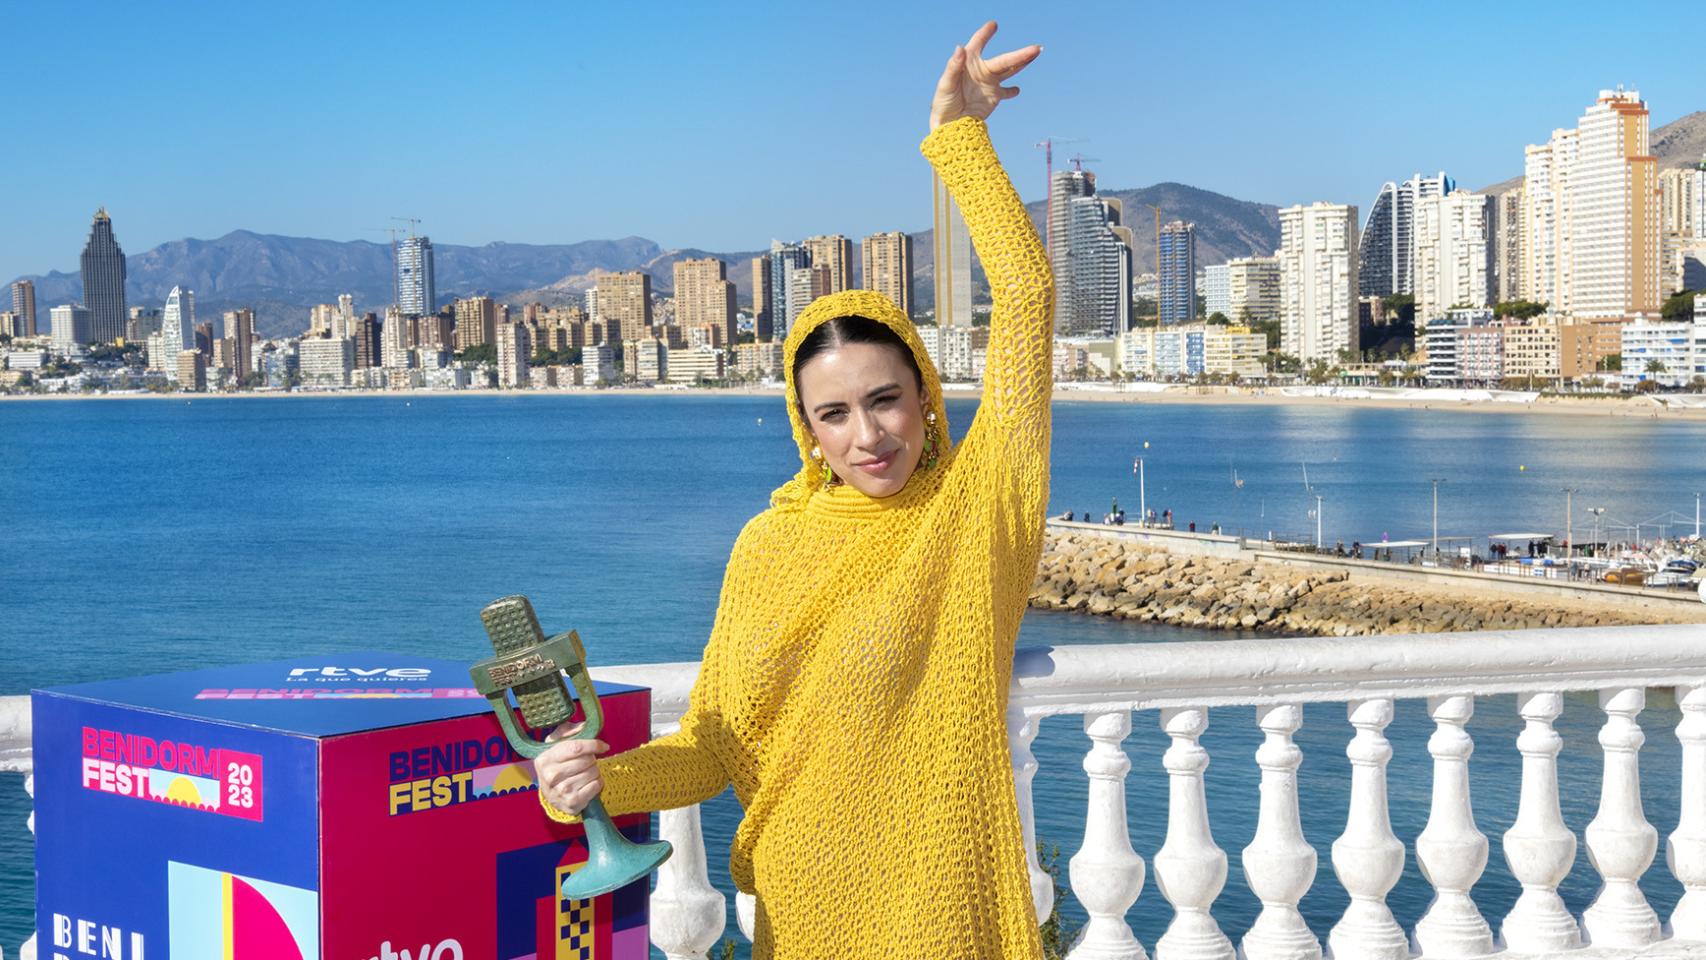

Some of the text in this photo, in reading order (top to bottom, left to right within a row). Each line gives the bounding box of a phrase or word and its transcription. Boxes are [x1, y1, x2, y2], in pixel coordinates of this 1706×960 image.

[290, 667, 431, 677] rtve
[82, 726, 219, 779] BENIDORM
[227, 762, 253, 786] 20
[389, 729, 548, 781] BENIDO
[82, 757, 150, 798] FEST
[228, 784, 254, 809] 23
[389, 771, 473, 816] FEST
[53, 912, 145, 960] BENI
